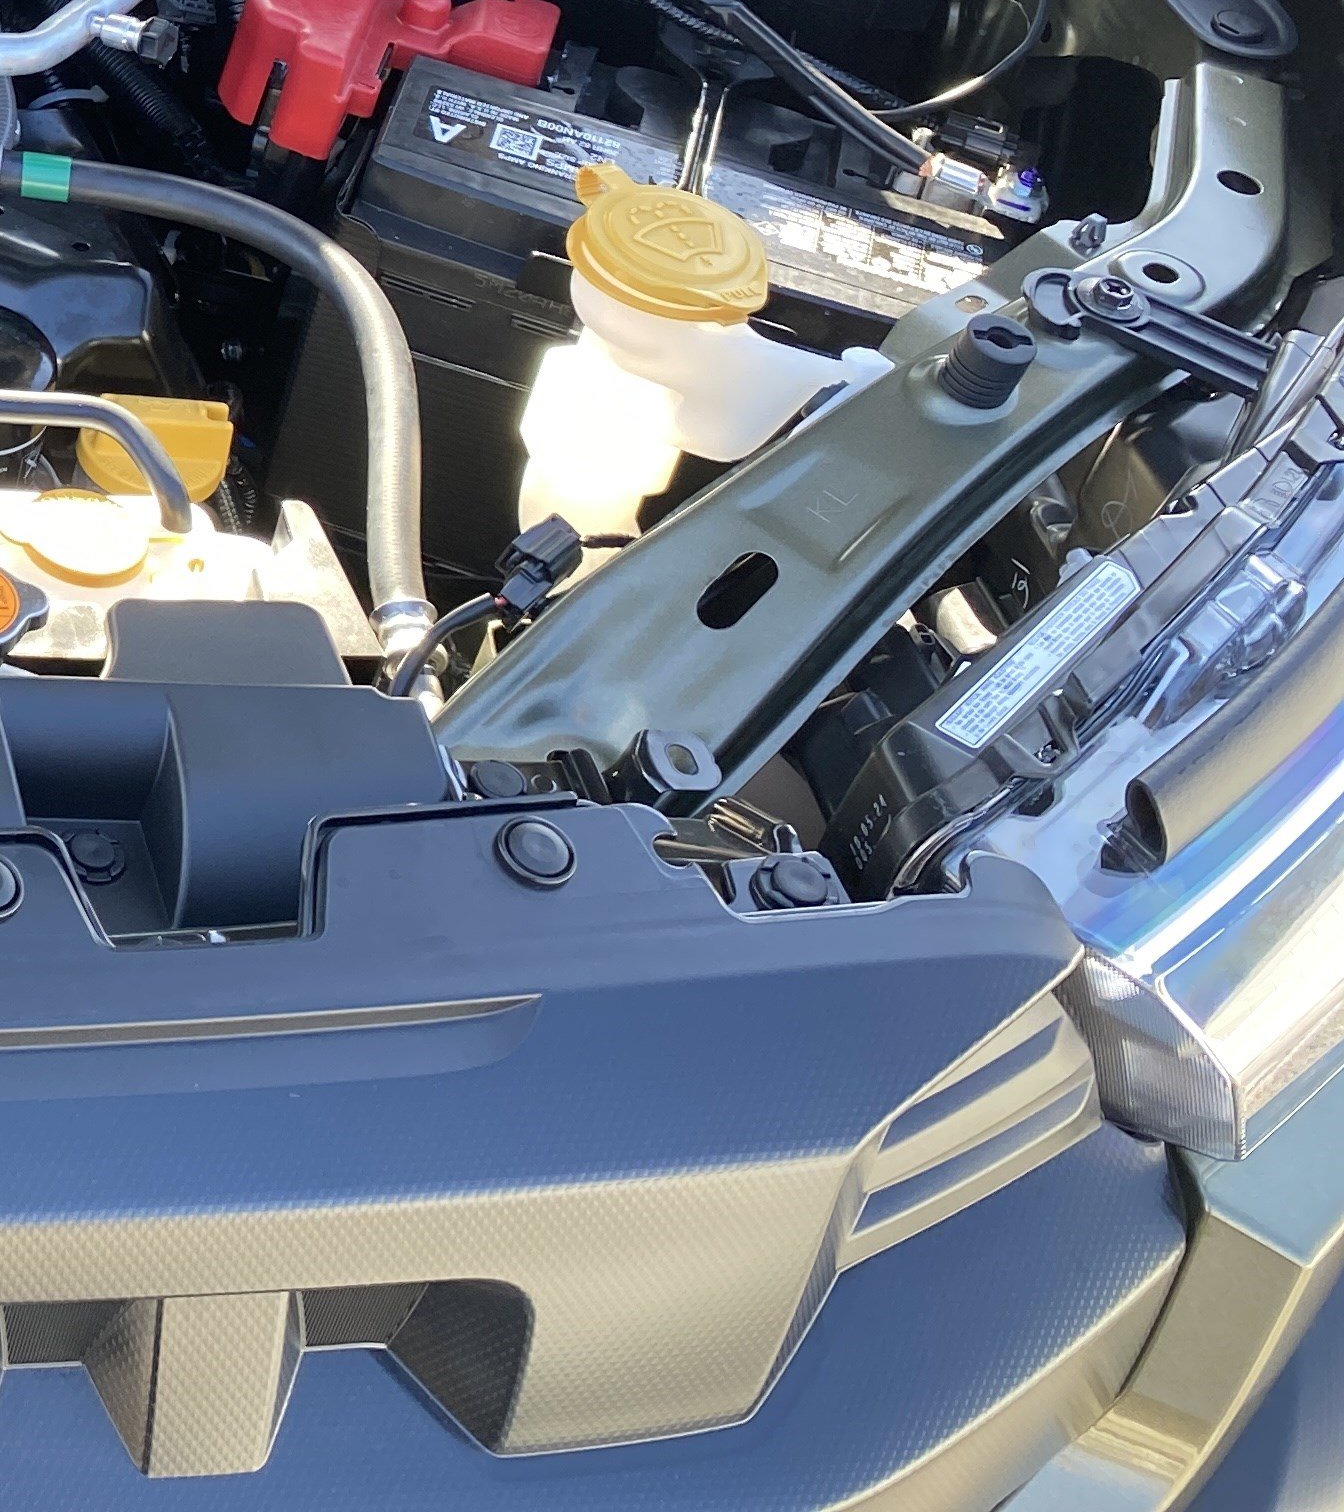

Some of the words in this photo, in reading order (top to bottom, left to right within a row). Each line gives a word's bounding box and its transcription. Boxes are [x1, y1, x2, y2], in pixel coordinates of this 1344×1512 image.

[429, 113, 467, 143] A
[537, 118, 621, 149] 82110AN00B
[498, 152, 526, 165] AMPS
[528, 161, 576, 180] RANKING
[805, 489, 860, 524] KL
